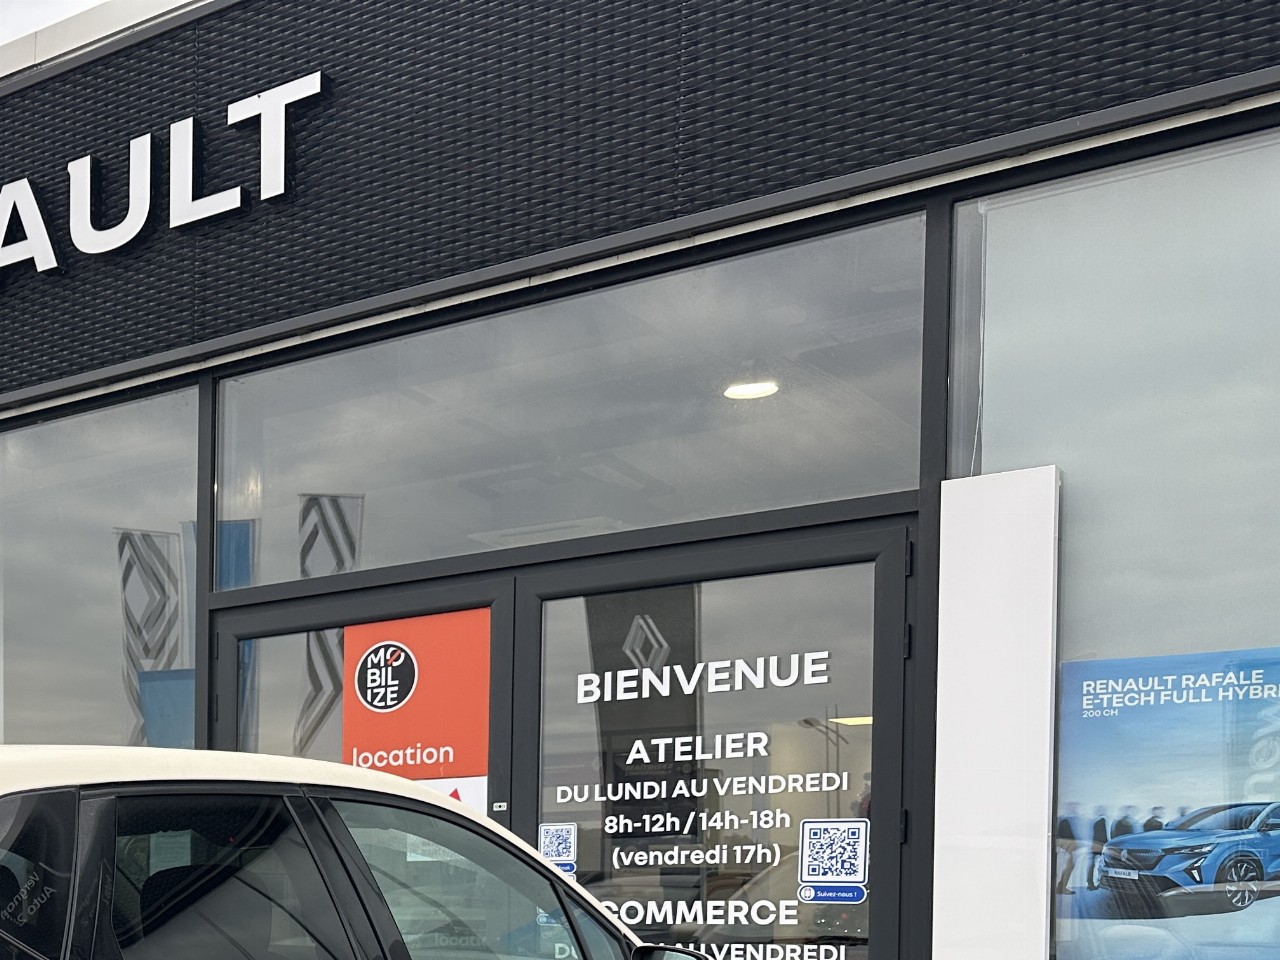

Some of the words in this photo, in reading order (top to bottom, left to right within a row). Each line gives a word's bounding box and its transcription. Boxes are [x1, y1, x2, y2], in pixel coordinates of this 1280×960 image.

[577, 650, 830, 704] BIENVENUE
[1082, 675, 1177, 694] RENAULT
[1181, 669, 1265, 689] RAFALE
[1082, 691, 1155, 709] E-TECH
[1159, 688, 1213, 705] FULL
[1082, 709, 1101, 718] 200
[1102, 708, 1119, 717] CH
[352, 743, 454, 768] location
[625, 731, 769, 765] ATELIER
[556, 784, 589, 804] DU
[594, 780, 667, 802] LUNDI
[671, 778, 708, 798] AU
[712, 771, 849, 796] VENDREDI
[604, 812, 680, 834] 8h-12h
[682, 811, 696, 836] /
[698, 808, 791, 831] 14h-18h
[612, 844, 728, 870] (vendredi
[732, 842, 781, 867] 17h)
